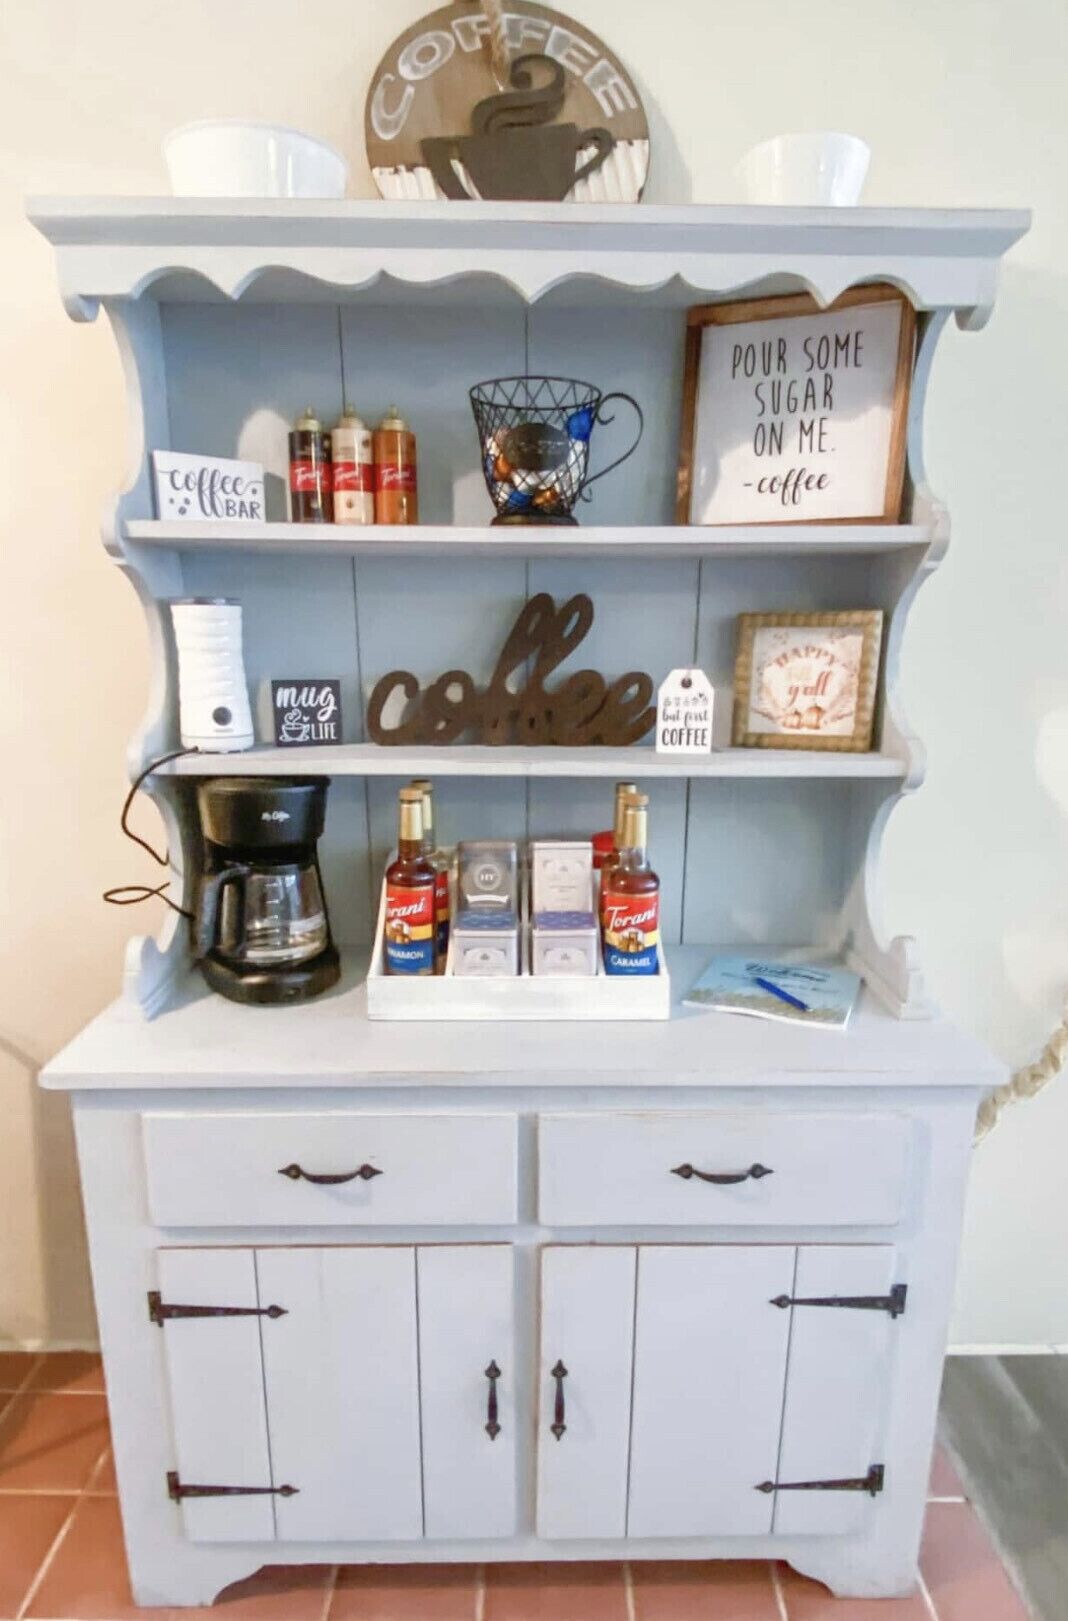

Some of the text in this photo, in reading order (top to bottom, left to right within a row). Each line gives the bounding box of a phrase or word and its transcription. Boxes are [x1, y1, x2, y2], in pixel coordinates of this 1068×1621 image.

[371, 13, 637, 140] COFFEE
[732, 330, 864, 379] POUR SOME
[754, 372, 834, 417] SUGAR
[753, 417, 836, 457] ON ME.
[160, 467, 263, 518] coffee
[743, 468, 830, 506] -coffee
[225, 503, 262, 519] BAR
[367, 592, 657, 746] coffee
[773, 645, 838, 668] HAPPY
[276, 686, 338, 721] mug
[786, 670, 832, 707] yall
[310, 721, 338, 740] LIFE
[662, 708, 708, 728] but first
[662, 727, 708, 746] COFFEE
[607, 901, 657, 931] Torani
[611, 954, 652, 967] CARAMEL
